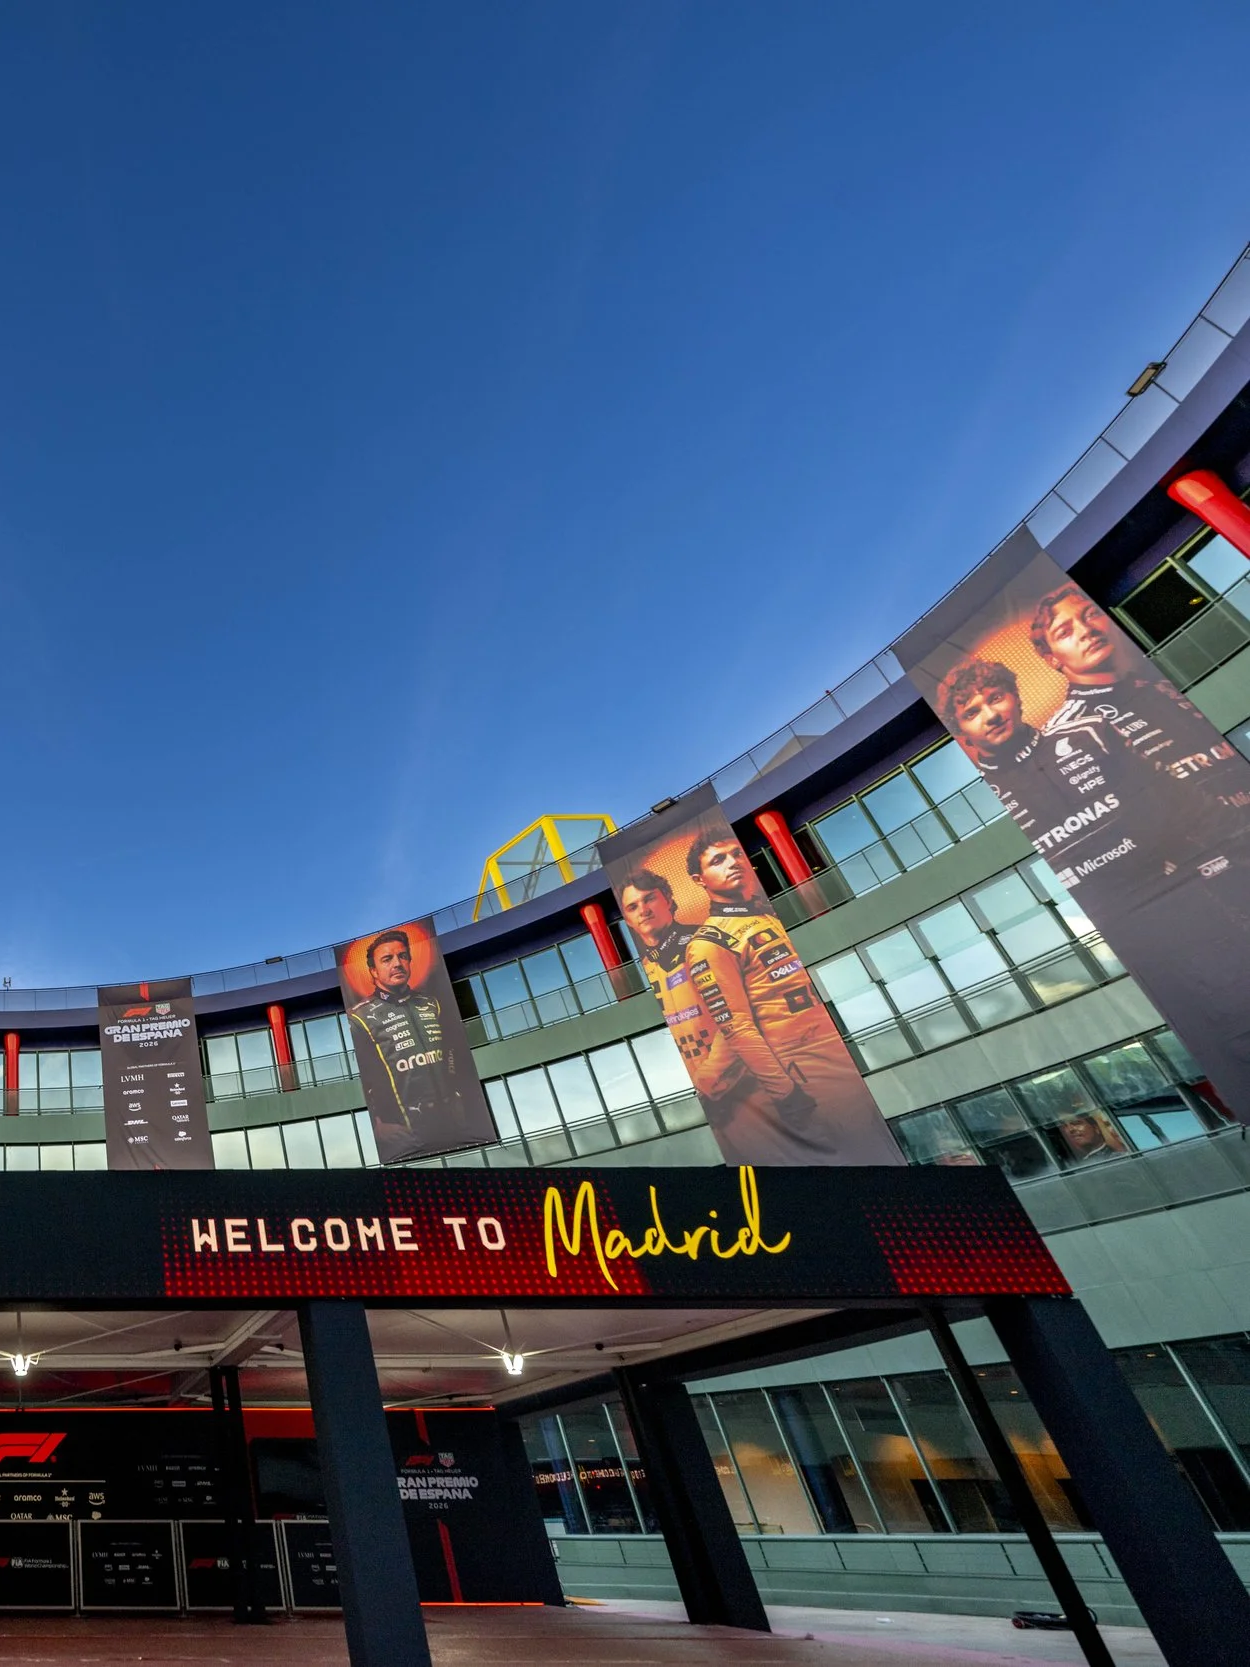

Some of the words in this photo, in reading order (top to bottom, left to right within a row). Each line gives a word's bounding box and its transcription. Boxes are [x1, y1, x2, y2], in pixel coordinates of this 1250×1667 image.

[1059, 753, 1094, 775] INEOS
[1078, 775, 1106, 794] HPE
[1031, 793, 1120, 854] ETRONAS
[1075, 837, 1137, 878] Microsoft
[771, 964, 797, 980] DELL
[104, 1024, 141, 1035] GRAN
[142, 1018, 191, 1032] PREMIO
[114, 1034, 131, 1043] DE
[392, 1029, 411, 1041] BOSS
[396, 1049, 443, 1072] aramc
[121, 1074, 144, 1083] LVMH
[191, 1217, 419, 1253] WELCOME
[443, 1216, 505, 1251] TO
[543, 1165, 792, 1291] Madrid
[396, 1476, 427, 1488] RAN
[427, 1476, 479, 1488] PREMIO
[13, 1494, 42, 1502] aramco
[88, 1491, 105, 1501] aws
[399, 1488, 418, 1500] DE
